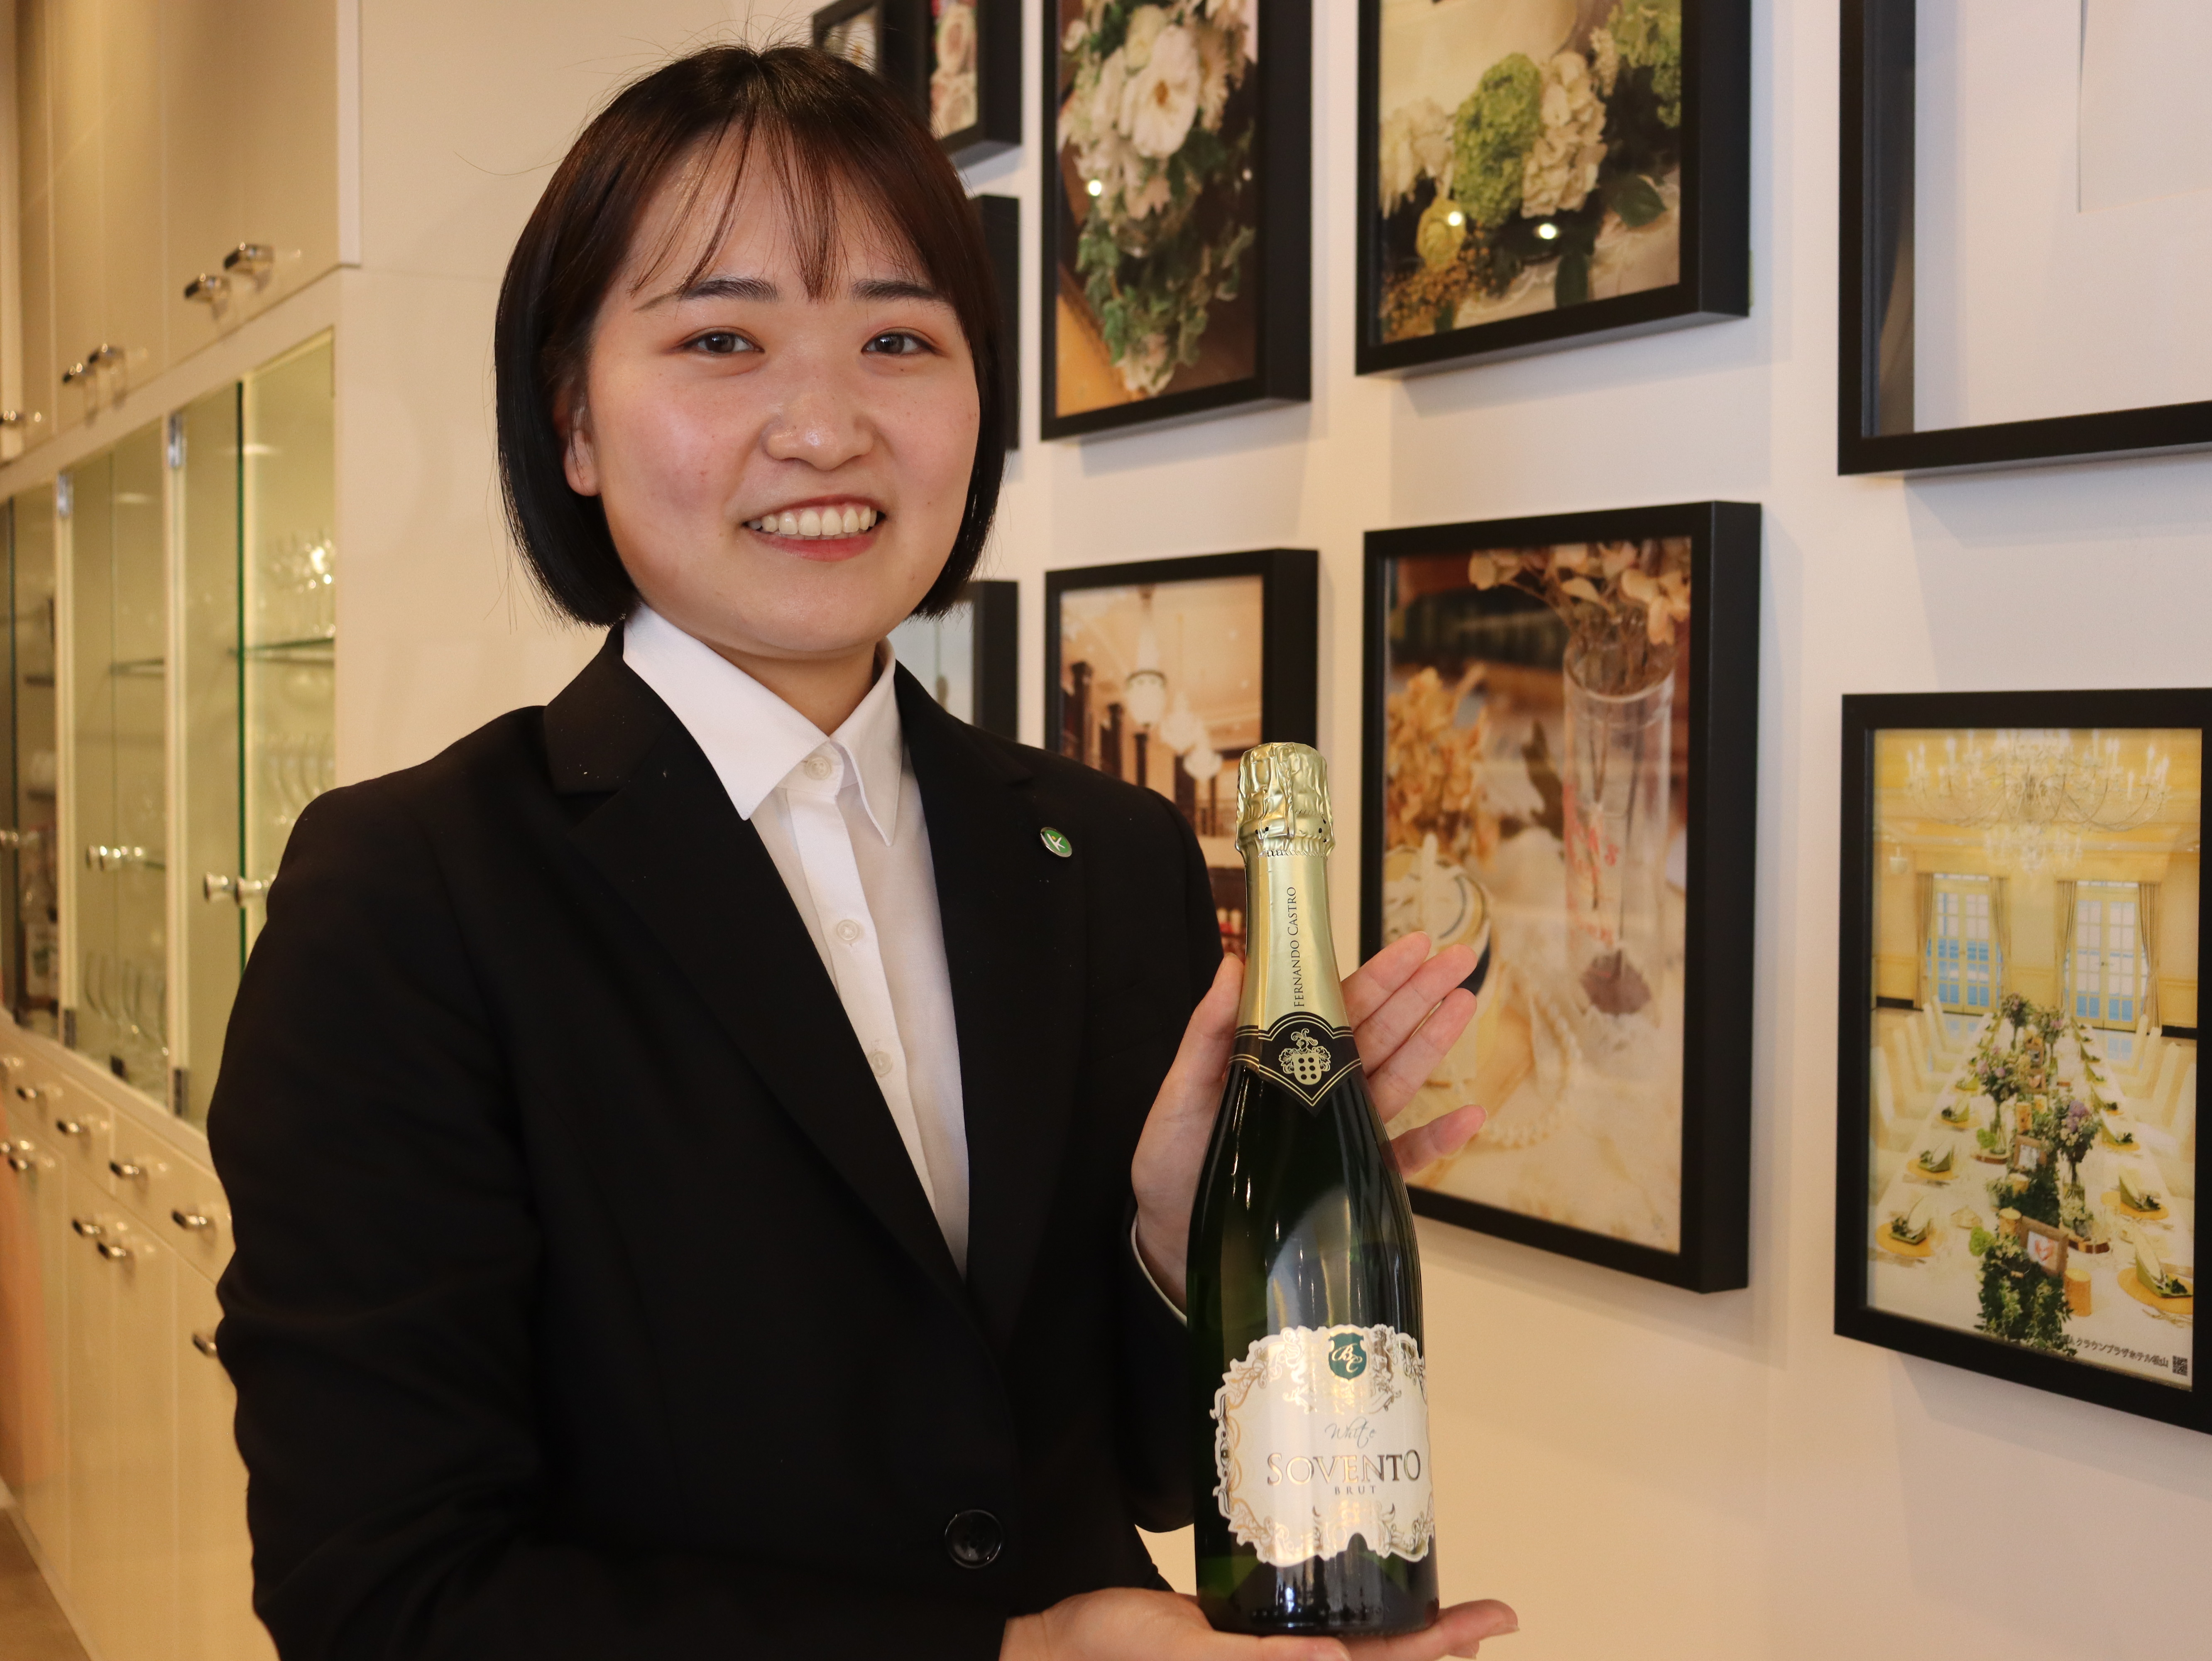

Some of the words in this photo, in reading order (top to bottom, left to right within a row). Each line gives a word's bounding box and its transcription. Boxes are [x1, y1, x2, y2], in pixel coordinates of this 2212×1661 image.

[1287, 887, 1299, 936] CASTRO
[1290, 940, 1304, 1007] FERNANDO
[1324, 1416, 1377, 1449] White
[1267, 1449, 1422, 1486] SOVENTO
[1334, 1485, 1377, 1495] BRUT
